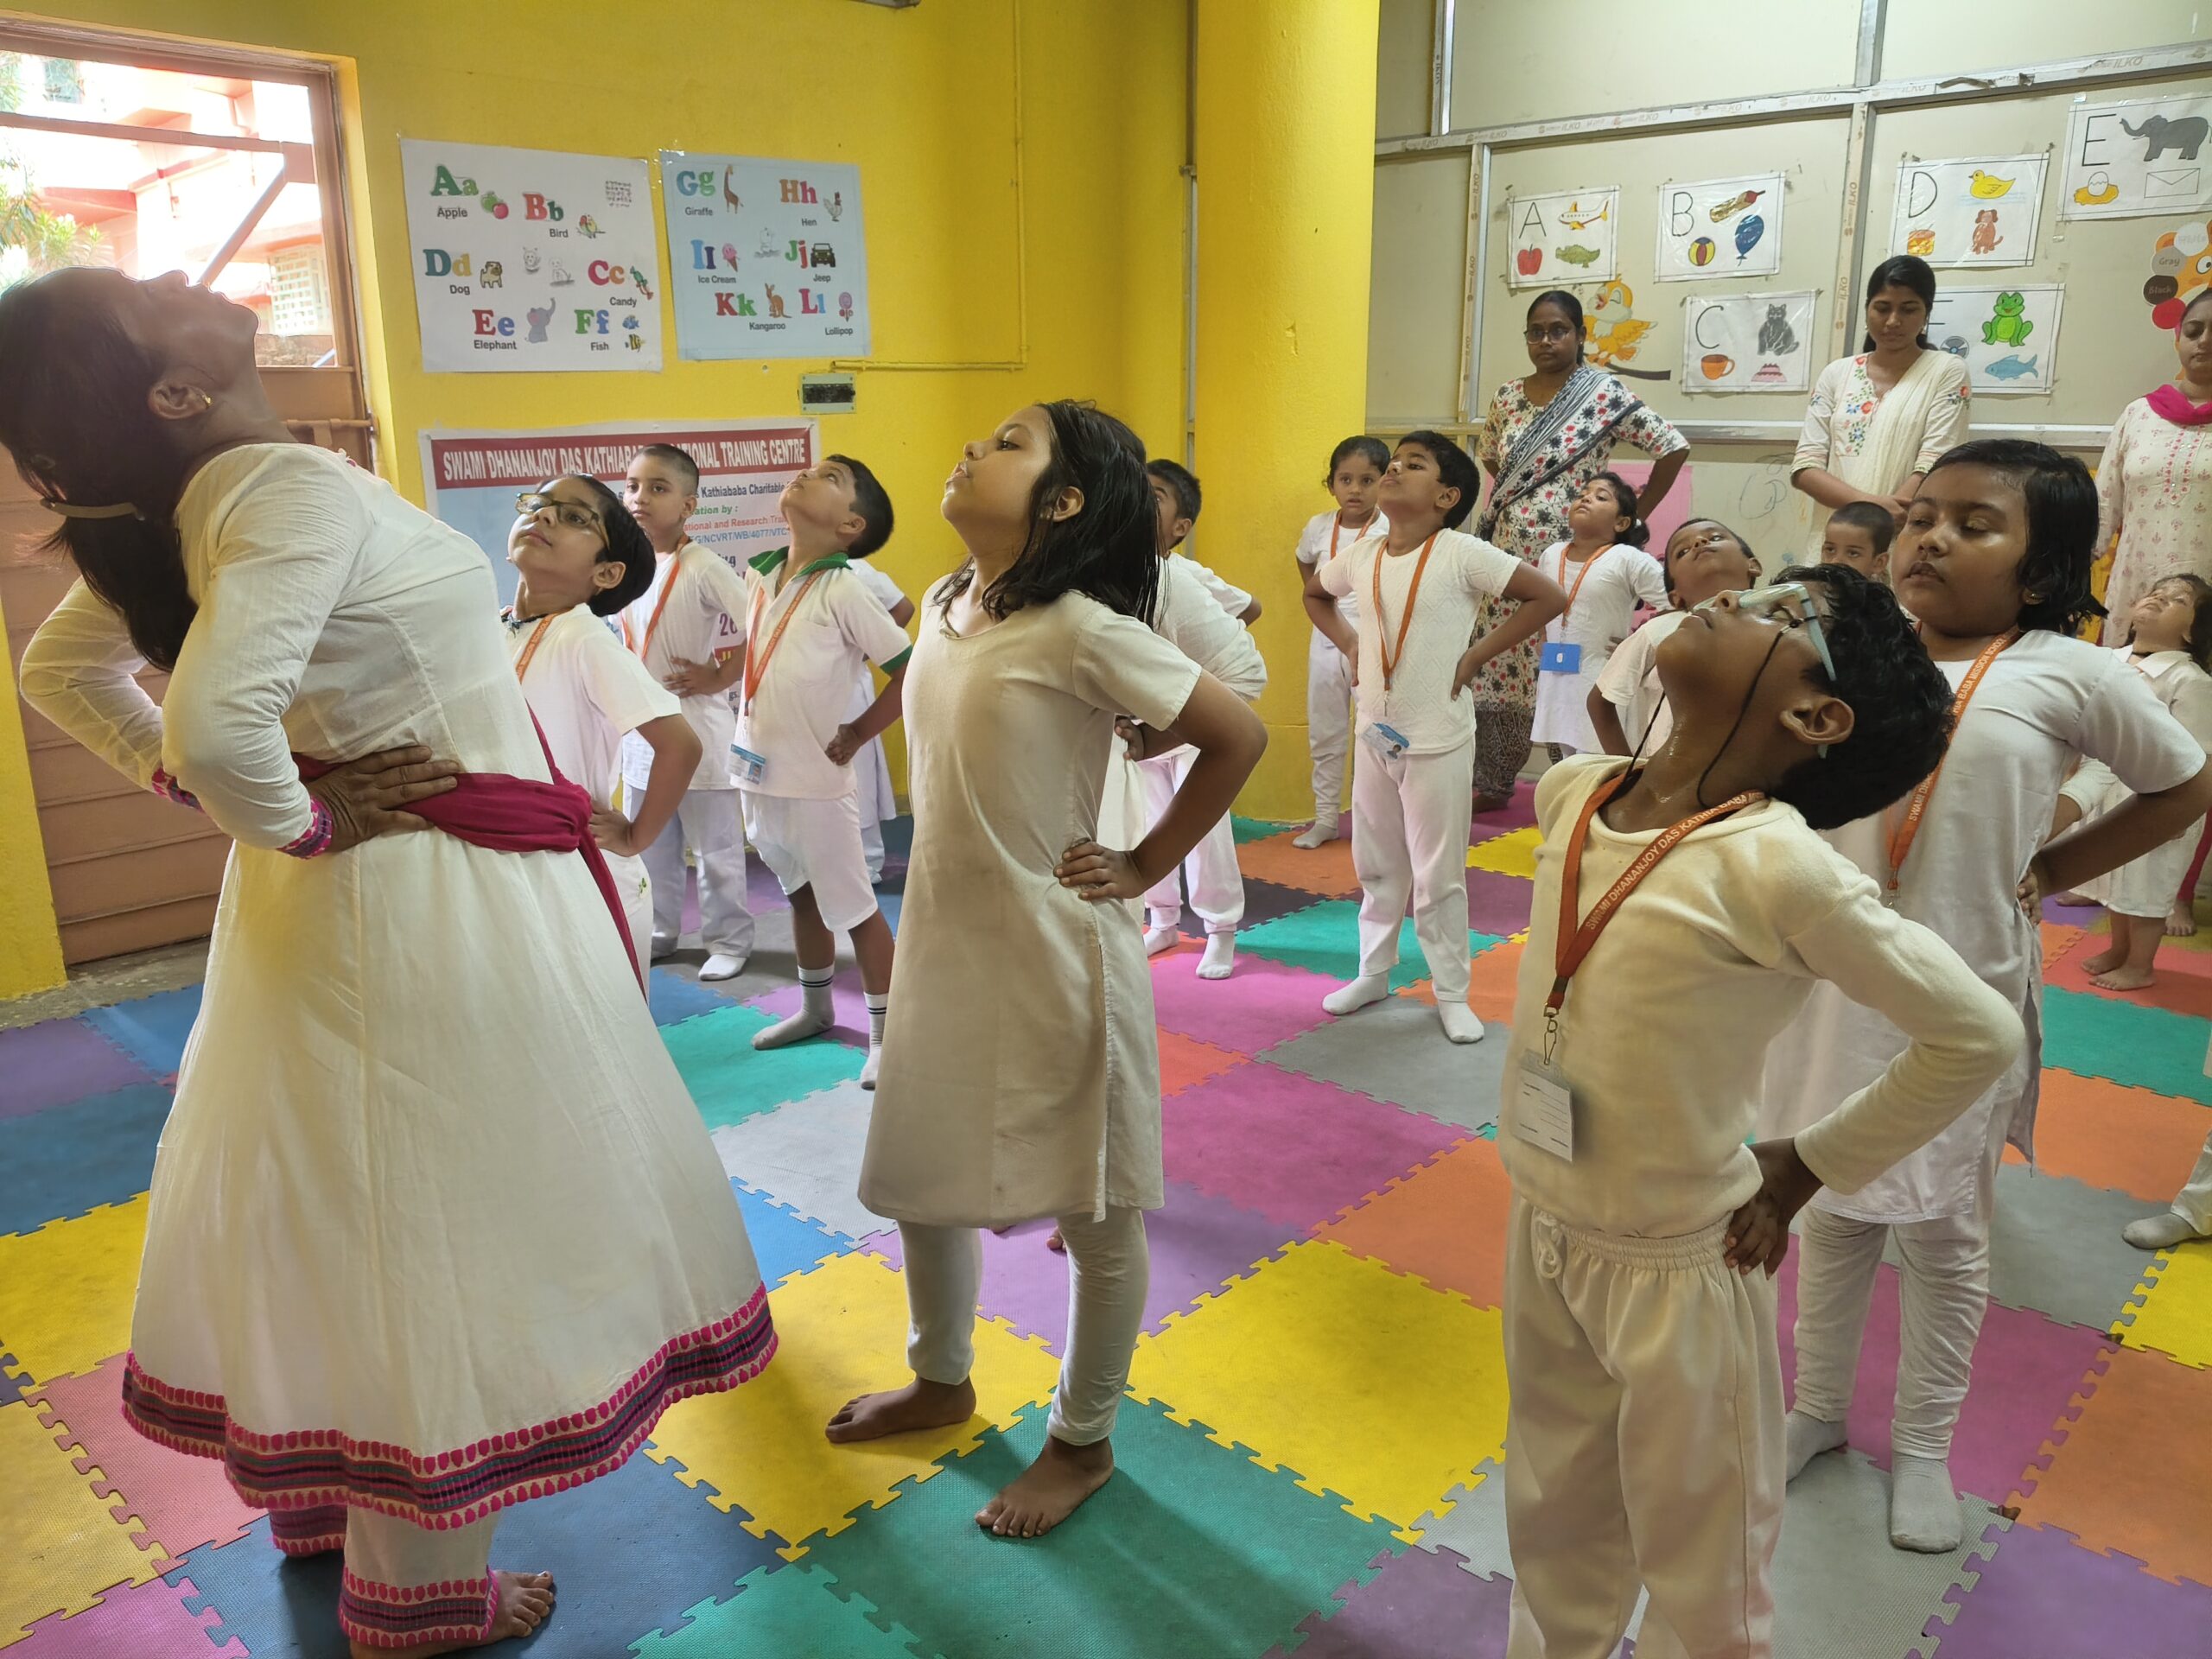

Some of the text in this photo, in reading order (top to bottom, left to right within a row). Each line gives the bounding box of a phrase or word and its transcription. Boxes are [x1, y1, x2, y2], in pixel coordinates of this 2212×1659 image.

[2082, 113, 2117, 167] E
[431, 164, 479, 195] Aa
[677, 171, 715, 196] Gg
[779, 179, 817, 204] Hh
[523, 193, 563, 221] Bb
[1909, 171, 1937, 218] D
[437, 207, 467, 219] Apple
[685, 207, 713, 216] Giraffe
[801, 218, 817, 226] Hen
[1519, 201, 1546, 238] A
[1672, 192, 1694, 237] B
[550, 228, 569, 238] Bird
[423, 249, 472, 276] Dd
[785, 240, 808, 269] Jj
[2159, 257, 2180, 267] Gray
[588, 260, 625, 285] Cc
[813, 274, 830, 283] Jeep
[450, 284, 470, 296] Dog
[610, 297, 637, 308] Candy
[715, 293, 757, 316] Kk
[473, 309, 515, 336] Ee
[575, 309, 609, 334] Ff
[749, 322, 785, 332] Kangaroo
[825, 327, 853, 336] Lollipop
[1695, 305, 1724, 349] C
[474, 340, 517, 351] Elephant
[591, 342, 609, 351] Fish
[443, 450, 486, 481] SWAMI
[486, 448, 558, 480] DHANANJOY
[560, 447, 583, 475] DAS
[720, 440, 768, 467] TRAINING
[770, 438, 805, 465] CENTRE
[701, 484, 747, 499] Kathiababa
[749, 482, 785, 495] Charitable
[721, 505, 733, 515] by
[714, 519, 729, 529] and
[732, 518, 768, 528] Research
[1957, 679, 1975, 700] BABA
[1969, 652, 1991, 680] MISSION
[1586, 899, 1611, 930] SWAMI
[1608, 845, 1660, 902] DHANANJOY
[1658, 829, 1681, 850] DAS
[1679, 807, 1720, 831] KATHIA
